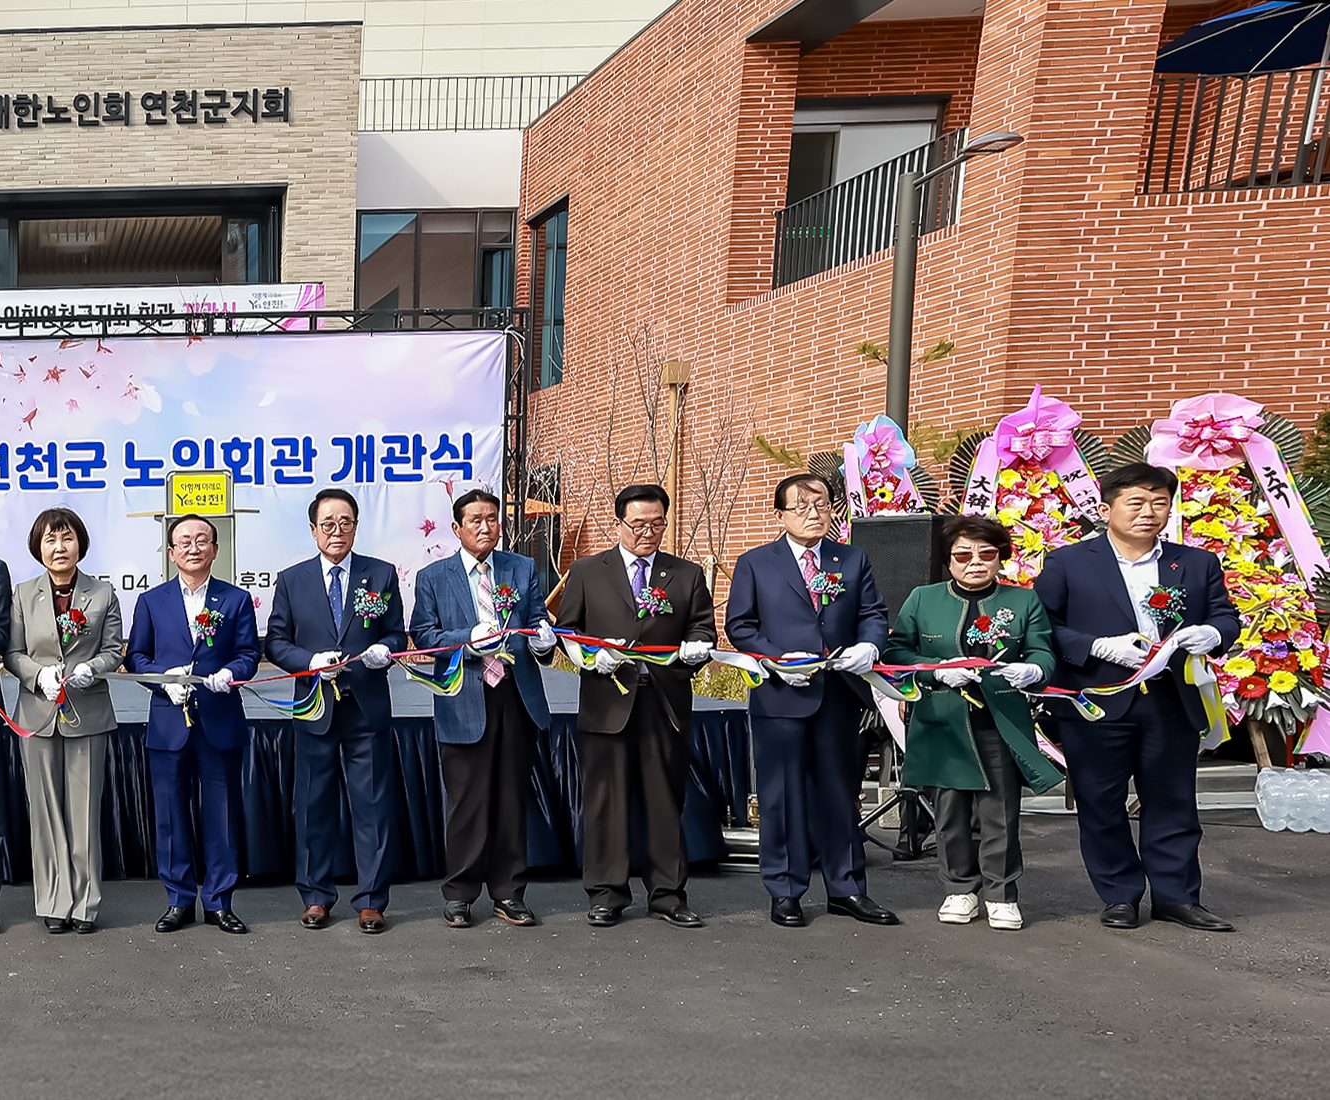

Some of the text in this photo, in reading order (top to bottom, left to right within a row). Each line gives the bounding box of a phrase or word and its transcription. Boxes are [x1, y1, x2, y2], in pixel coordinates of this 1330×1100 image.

[140, 87, 290, 126] 연천군지회
[123, 436, 318, 487] 노인회관
[331, 432, 474, 483] 개관식
[176, 493, 194, 507] Yes
[965, 475, 993, 517] 大韓
[1261, 466, 1291, 509] 축
